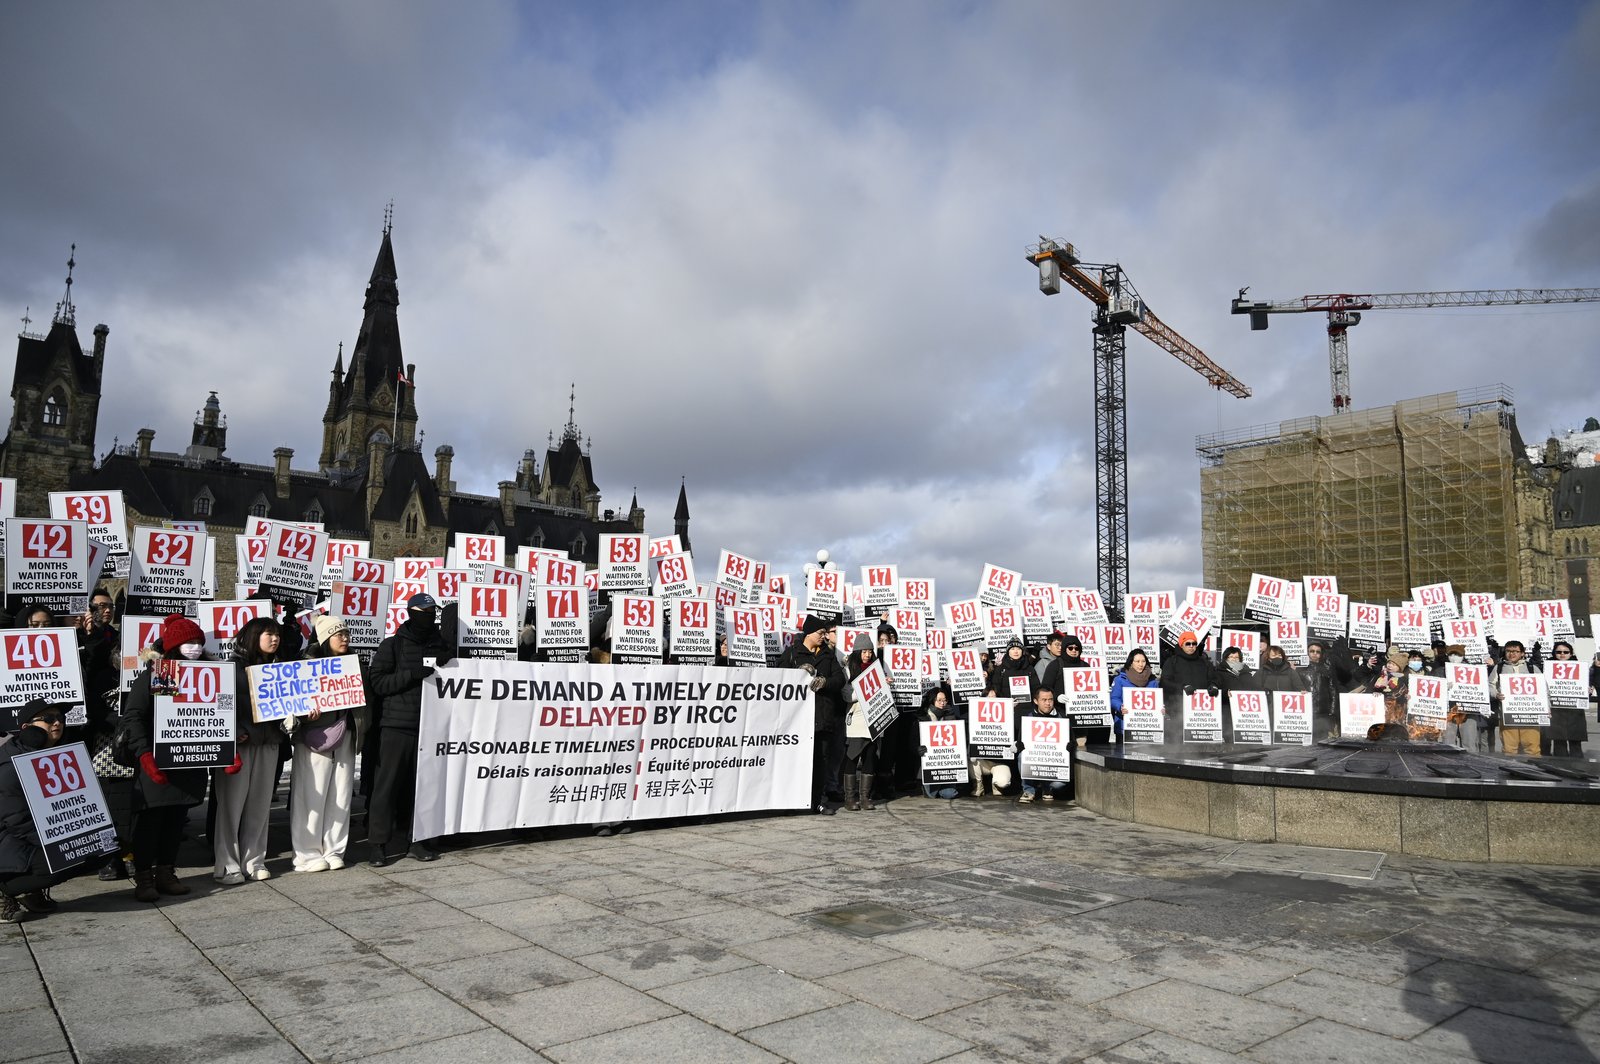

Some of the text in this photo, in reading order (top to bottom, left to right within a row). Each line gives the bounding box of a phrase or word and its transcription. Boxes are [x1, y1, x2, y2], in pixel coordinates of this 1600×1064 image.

[71, 497, 106, 523] 39
[28, 525, 67, 558] 42
[152, 534, 187, 565] 32
[283, 532, 312, 560] 42
[468, 538, 492, 560] 34
[614, 538, 637, 562] 53
[150, 568, 185, 577] MONTHS
[272, 567, 299, 578] WAITING
[280, 560, 308, 571] MONTHS
[357, 563, 381, 583] 22
[551, 562, 572, 585] 15
[661, 558, 684, 583] 68
[728, 556, 746, 578] 33
[13, 582, 83, 590] IRCC RESPONSE
[140, 575, 175, 584] WAITING
[265, 574, 280, 583] IRCC
[281, 578, 316, 589] RESPONSE
[442, 574, 462, 596] 31
[818, 572, 836, 591] 33
[872, 569, 889, 585] 17
[993, 569, 1011, 590] 43
[1312, 579, 1330, 592] 22
[153, 586, 196, 595] RESPONSE
[908, 582, 926, 599] 38
[1262, 579, 1279, 597] 70
[1423, 588, 1444, 604] 90
[347, 587, 373, 615] 31
[477, 589, 502, 616] 11
[552, 591, 575, 617] 71
[1025, 600, 1042, 616] 65
[1078, 595, 1096, 610] 63
[1134, 596, 1152, 612] 27
[1196, 592, 1215, 607] 16
[1318, 596, 1339, 612] 36
[627, 600, 651, 626] 53
[683, 602, 705, 626] 34
[955, 604, 974, 622] 30
[992, 609, 1012, 627] 55
[1183, 607, 1204, 629] 35
[1358, 607, 1377, 624] 28
[1400, 611, 1421, 626] 37
[1504, 604, 1525, 619] 39
[1541, 603, 1562, 618] 37
[218, 607, 252, 638] 40
[738, 612, 754, 634] 51
[899, 611, 916, 629] 34
[1079, 628, 1095, 643] 62
[1107, 627, 1124, 644] 72
[1138, 627, 1153, 644] 23
[1279, 623, 1297, 638] 31
[1455, 622, 1476, 637] 31
[928, 631, 944, 648] 30
[1233, 634, 1249, 650] 11
[12, 634, 55, 668] 40
[894, 649, 913, 670] 33
[953, 651, 973, 670] 24
[15, 672, 58, 681] MONTHS
[262, 658, 341, 682] STOP THE
[1458, 666, 1478, 684] 37
[1555, 663, 1578, 678] 37
[5, 681, 70, 692] WAITING FOR
[180, 667, 216, 702] 40
[435, 678, 808, 701] WE DEMAND A TIMELY DECISION
[863, 670, 881, 697] 41
[1075, 672, 1098, 691] 34
[1419, 679, 1440, 698] 37
[1511, 677, 1536, 694] 36
[24, 690, 78, 701] RESPONSE
[1134, 691, 1154, 710] 35
[1194, 694, 1213, 710] 18
[1241, 695, 1259, 712] 36
[1284, 695, 1304, 713] 21
[177, 708, 215, 716] MONTHS
[540, 705, 737, 727] DELAYED BY IRCC
[980, 702, 1003, 721] 40
[167, 718, 225, 727] WAITING FOR
[1034, 722, 1058, 741] 22
[161, 729, 230, 739] IRCC RESPONSE
[932, 725, 956, 745] 43
[436, 734, 799, 756] REASONABLE TIMELINES PROCEDURAL FAIRNESS
[38, 753, 80, 795] 36
[477, 756, 765, 779] Délais raisonnables Équité procédurale
[549, 778, 714, 803] 给出时限 程序公平
[51, 794, 86, 811] MONTHS
[46, 803, 99, 826] WAITING FOR
[45, 813, 106, 838] IRCC RESPONSE
